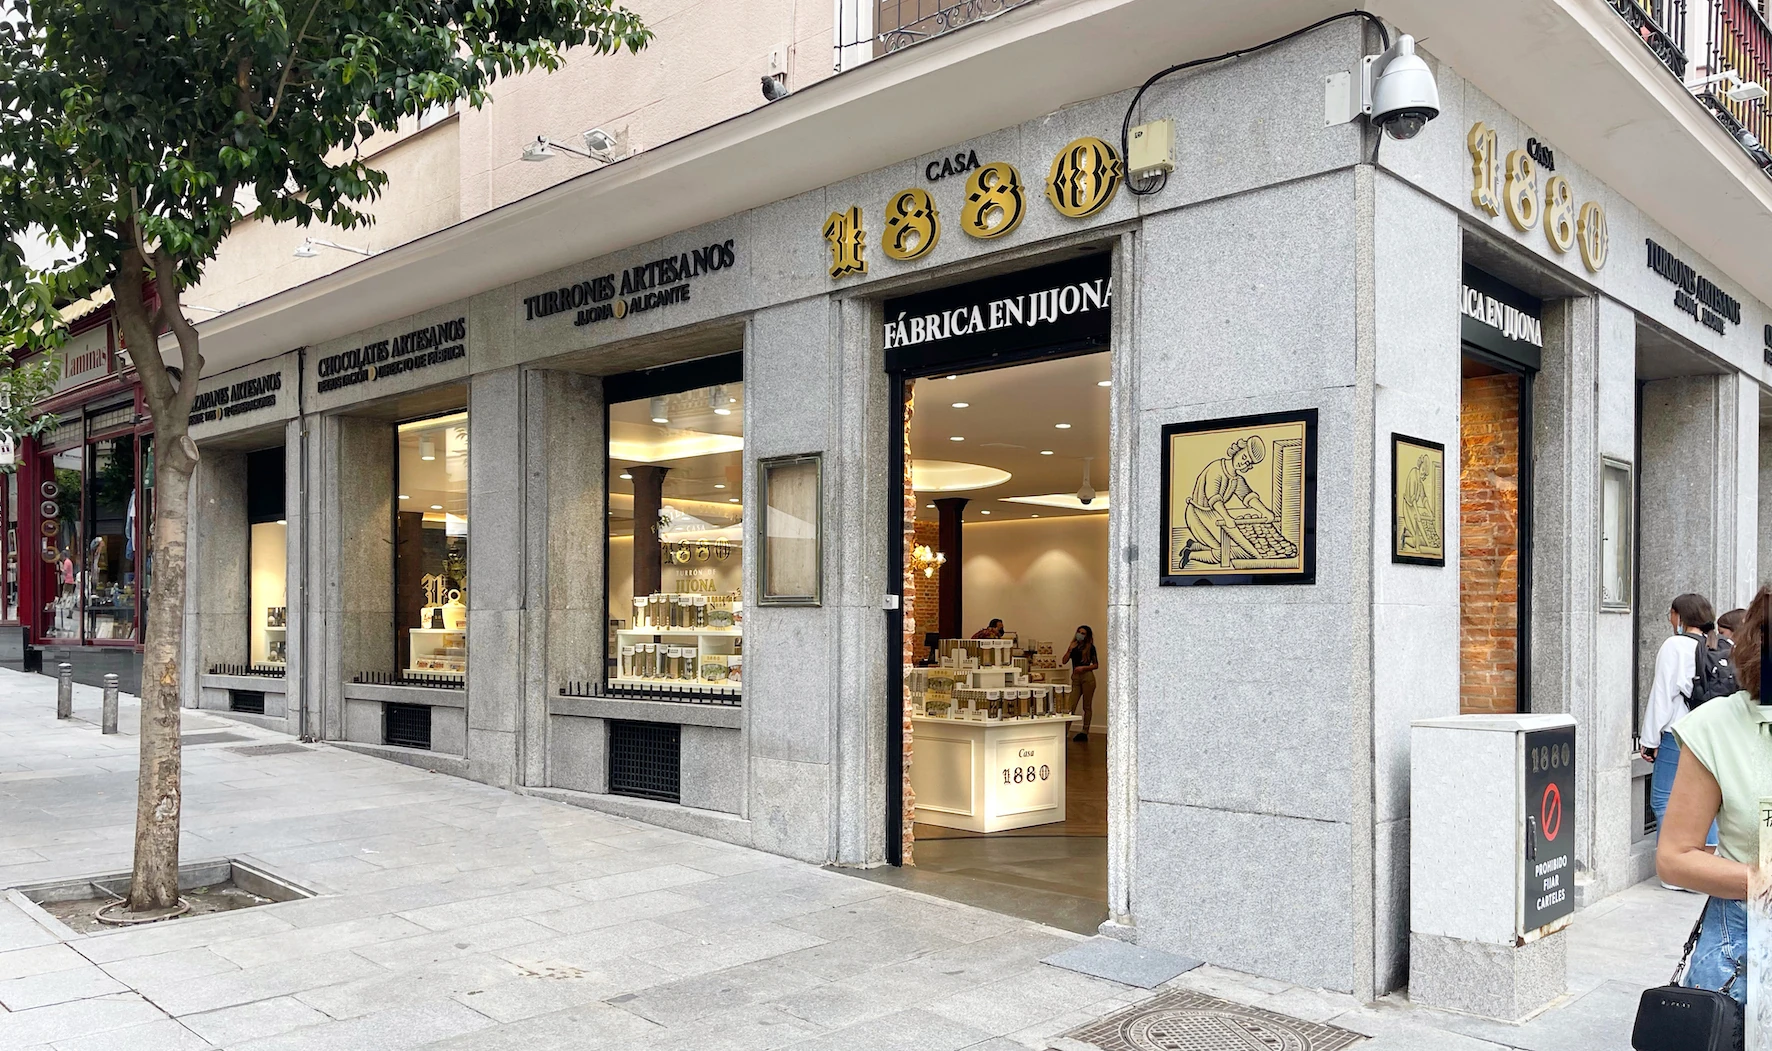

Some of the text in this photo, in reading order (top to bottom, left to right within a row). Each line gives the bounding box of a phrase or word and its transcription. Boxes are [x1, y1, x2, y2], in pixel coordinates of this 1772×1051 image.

[925, 150, 982, 182] CASA
[1526, 137, 1555, 171] CASA
[823, 136, 1123, 280] 1880
[1467, 121, 1609, 273] 1880
[523, 239, 735, 321] TURRONES ARTESANOS
[1645, 238, 1740, 325] TURRONES ARTESANOS
[629, 284, 690, 314] ALICANTE
[883, 305, 986, 350] FÁBRICA
[988, 295, 1025, 330] EN
[1461, 284, 1543, 347] ICA EN JIJONA
[318, 317, 466, 378] CHOCOLATES ARTESANOS
[230, 371, 282, 402] ARTESANOS
[675, 579, 717, 594] JIJONA
[1018, 748, 1035, 758] Casa
[1531, 742, 1570, 774] 1880
[1002, 764, 1050, 784] 1880
[1535, 855, 1568, 877] PROHIBIDO
[1543, 874, 1560, 891] FIJAR
[1536, 888, 1566, 911] CARTELES
